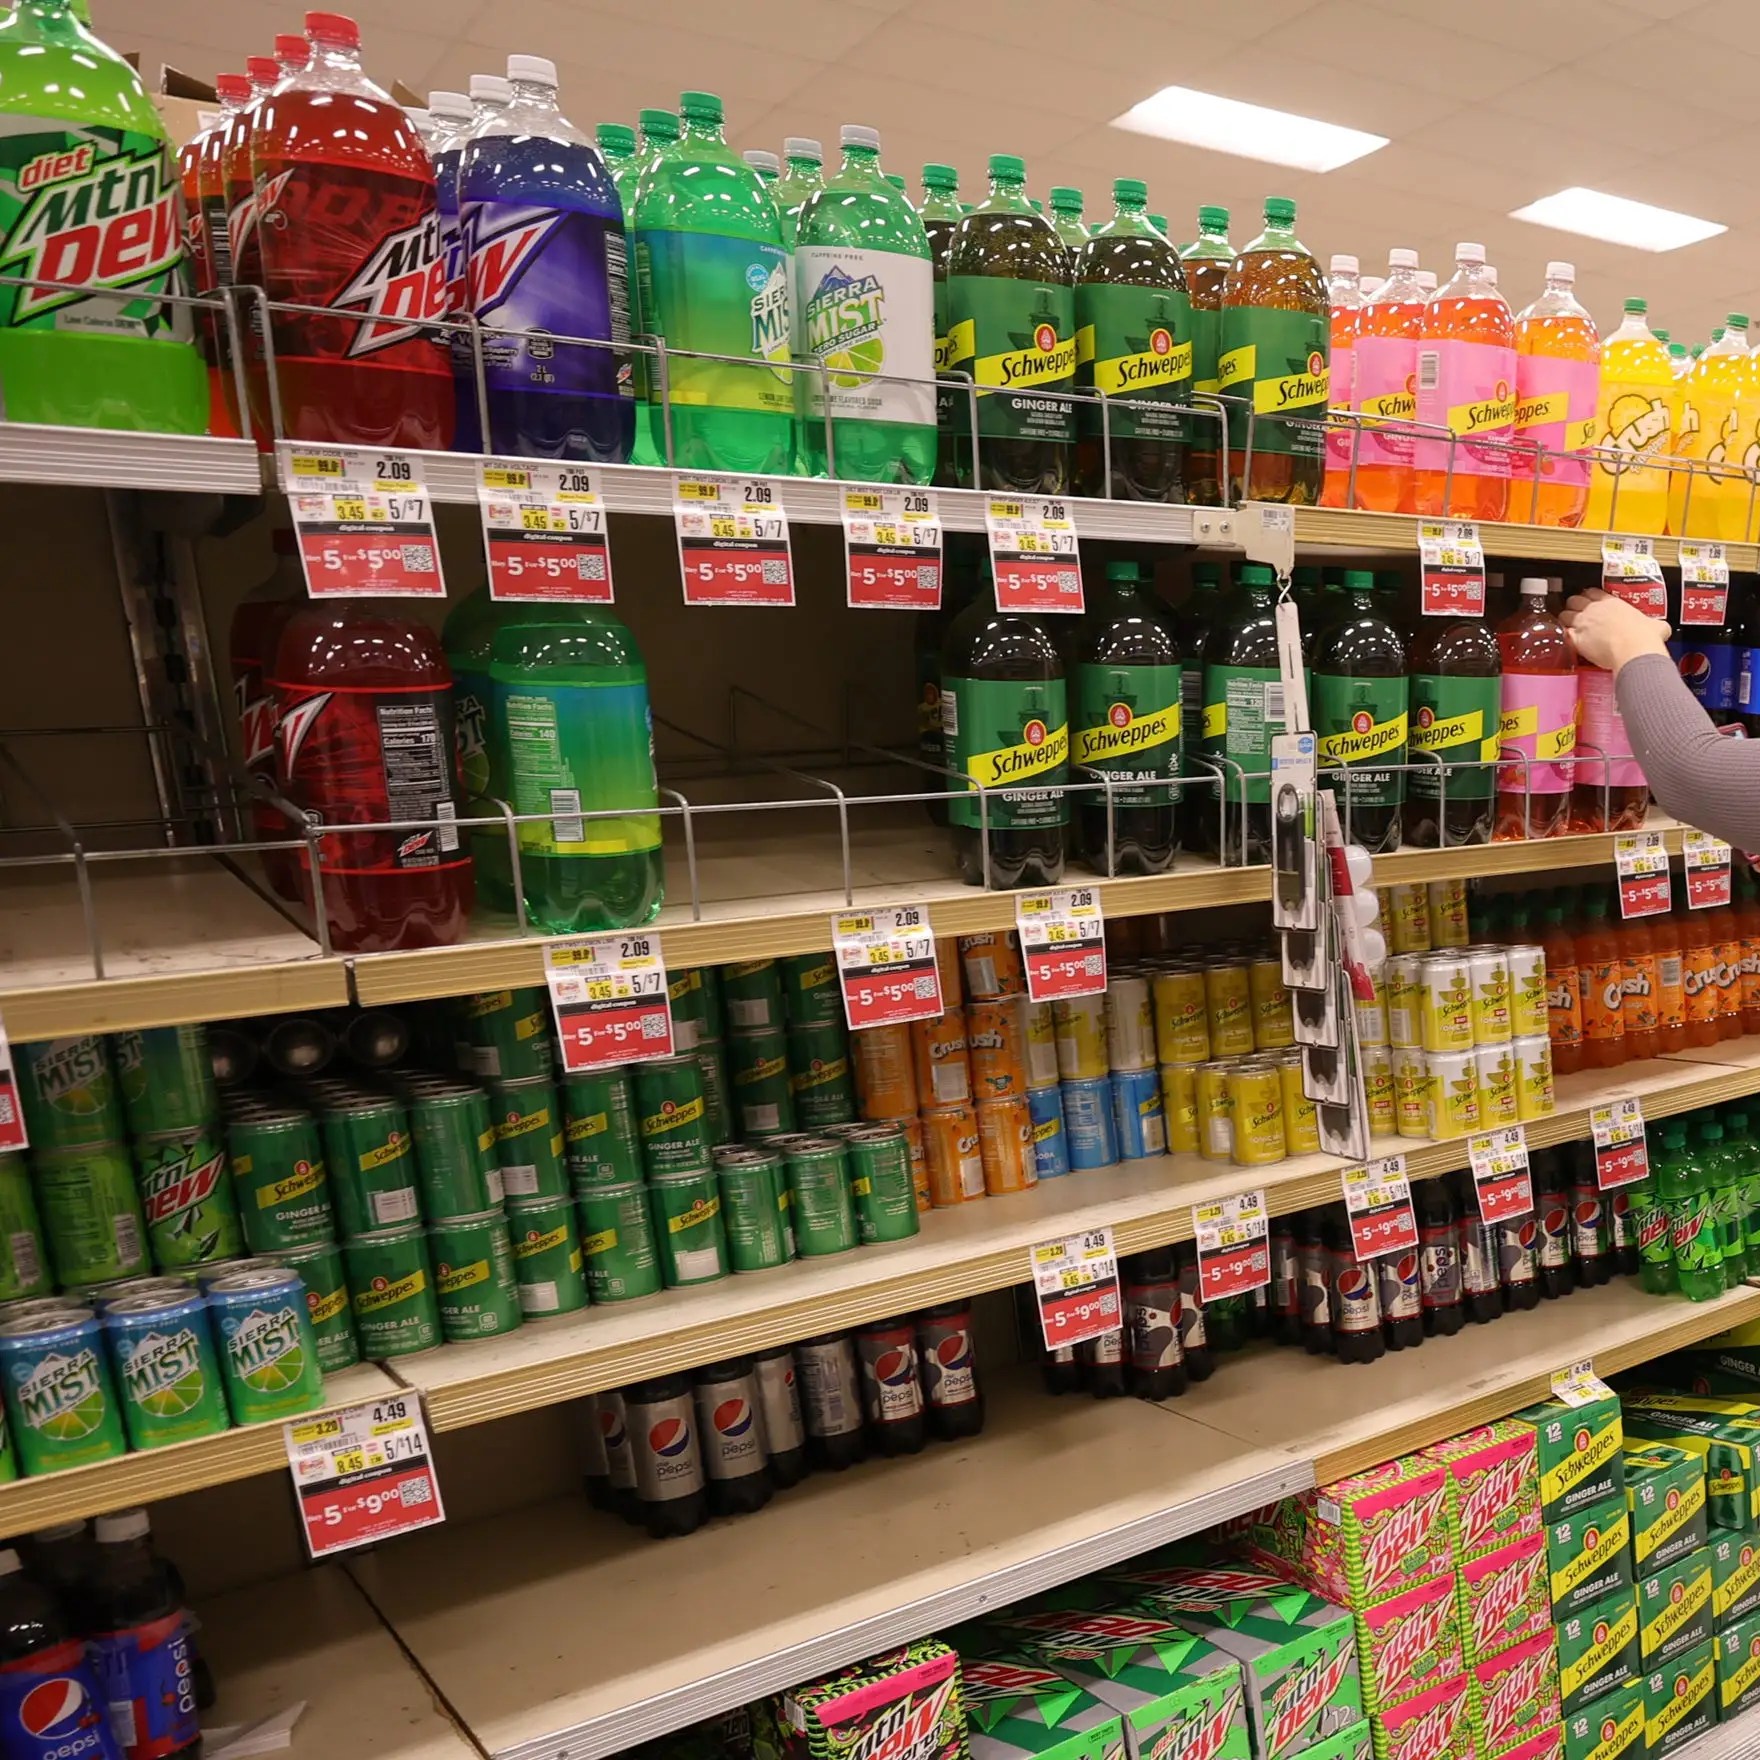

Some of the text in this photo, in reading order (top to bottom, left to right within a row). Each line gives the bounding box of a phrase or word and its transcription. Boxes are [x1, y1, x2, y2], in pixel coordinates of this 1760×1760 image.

[21, 147, 91, 188] diet
[19, 165, 156, 244] Mtn
[753, 286, 785, 311] SIER
[807, 278, 877, 318] SIERRA
[753, 300, 789, 350] MIS
[809, 289, 884, 347] MIST
[839, 322, 876, 344] SUGAR
[1001, 345, 1077, 386] Schweppes
[1117, 352, 1192, 387] Schweppes
[1012, 398, 1072, 413] GINGER ALE
[377, 461, 411, 480] 2.09
[559, 474, 589, 492] 2.09
[745, 486, 771, 503] 2.09
[337, 506, 364, 520] 3.45
[904, 497, 929, 513] 2.09
[1043, 505, 1065, 520] 2.09
[524, 515, 547, 529] 3.45
[713, 524, 735, 537] 3.45
[877, 532, 896, 545] 3.45
[1457, 527, 1473, 540] 2.09
[323, 550, 342, 570] 5
[508, 556, 524, 576] 5
[699, 563, 714, 581] 5
[863, 568, 876, 585] 5
[379, 706, 433, 717] Nutrition Facts
[382, 736, 415, 748] Calories
[539, 729, 556, 739] 140
[1082, 716, 1168, 760] Schweppes
[1325, 722, 1400, 758] Schweppes
[991, 733, 1069, 780] Schweppes
[1090, 770, 1157, 783] GINGER ALE
[1332, 771, 1391, 785] GINGER ALE
[1002, 789, 1065, 802] GINGER ALE
[1071, 892, 1092, 907] 2.09
[895, 911, 919, 927] 2.09
[621, 941, 650, 958] 2.09
[589, 985, 612, 999] 3.45
[859, 989, 873, 1006] 5
[578, 1027, 593, 1046] 5
[644, 1102, 701, 1135] Schweppes
[648, 1139, 700, 1151] GINGER ALE
[1505, 1132, 1520, 1145] 4.49
[1383, 1160, 1400, 1174] 4.49
[1239, 1195, 1258, 1209] 4.49
[276, 1207, 318, 1221] GINGER
[1084, 1233, 1105, 1249] 4.49
[1055, 1311, 1067, 1327] 5
[1341, 1304, 1370, 1319] pepsi
[228, 1308, 292, 1349] SIERRA
[397, 1315, 421, 1328] ALE
[122, 1329, 192, 1375] SIERRA
[231, 1317, 300, 1375] MIST
[19, 1349, 92, 1399] SIERRA
[129, 1338, 199, 1398] MIST
[23, 1360, 99, 1425] MIST
[883, 1389, 913, 1403] pepsi
[373, 1402, 407, 1423] 4.49
[1546, 1422, 1562, 1437] 12
[722, 1440, 754, 1457] pepsi
[337, 1456, 364, 1474] 8.45
[1555, 1431, 1616, 1492] Schweppes
[1565, 1479, 1612, 1506] GINGER ALE
[324, 1505, 343, 1526] 5
[1556, 1523, 1571, 1537] 12
[1564, 1527, 1622, 1588] Schweppes
[1573, 1572, 1619, 1600] GINGER ALE
[168, 1638, 195, 1714] pepsi
